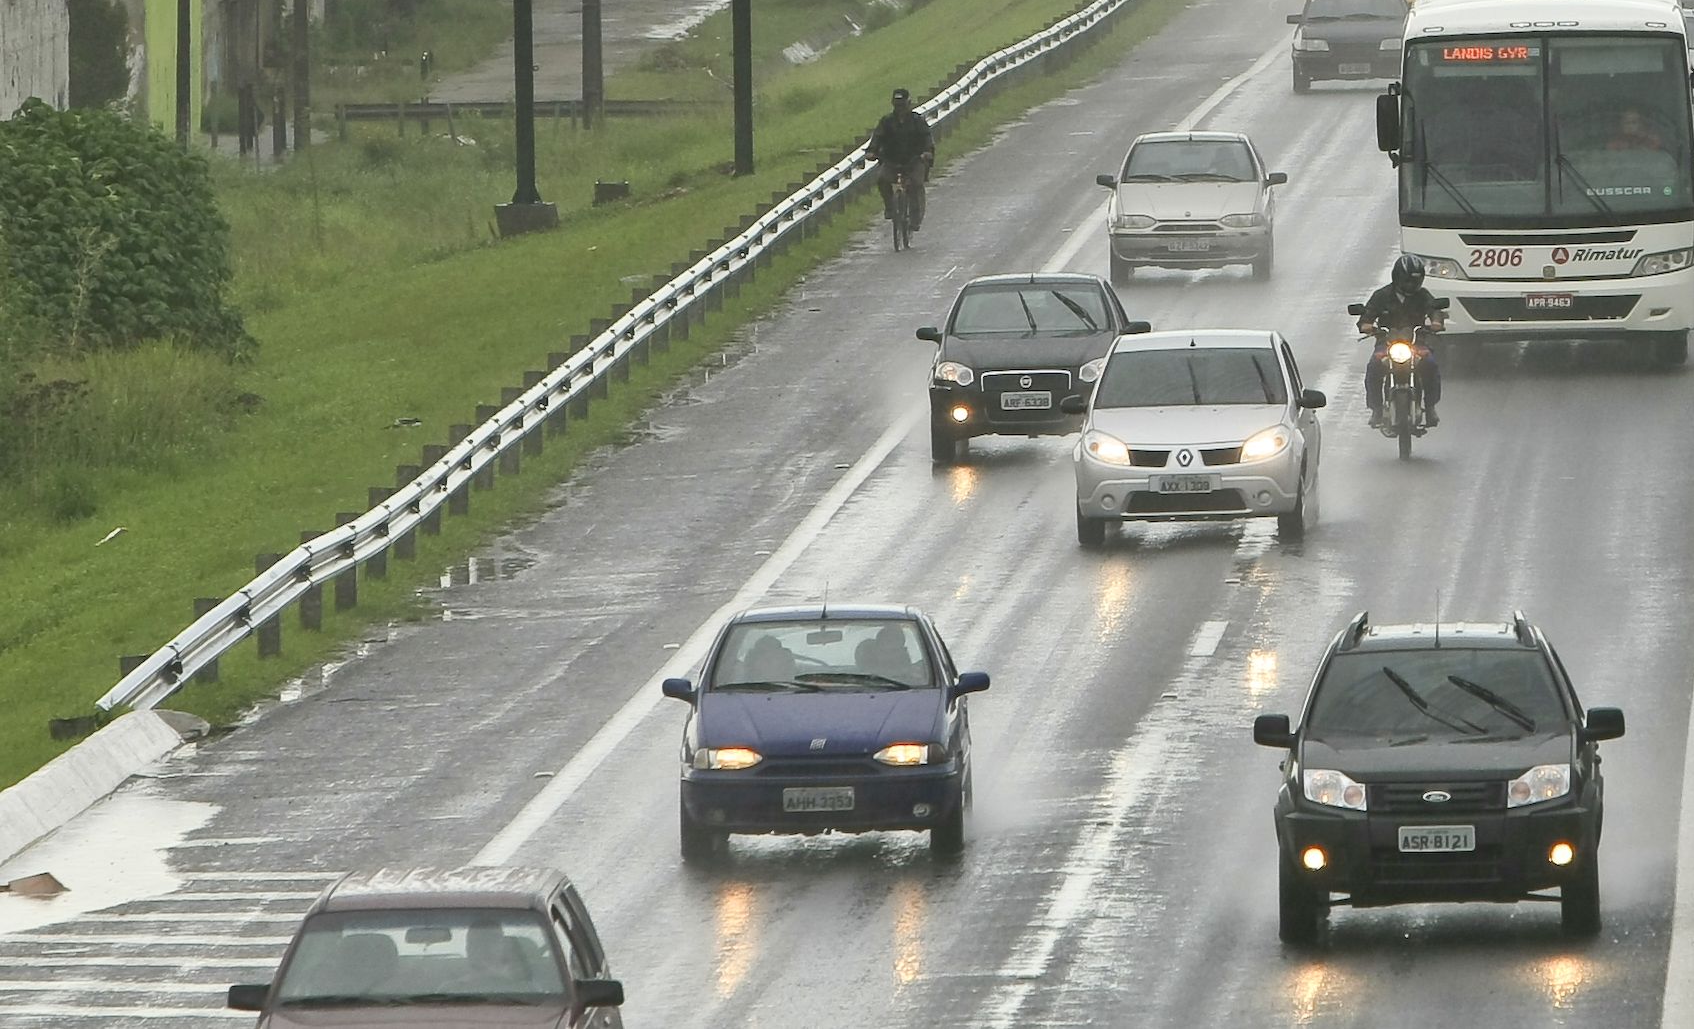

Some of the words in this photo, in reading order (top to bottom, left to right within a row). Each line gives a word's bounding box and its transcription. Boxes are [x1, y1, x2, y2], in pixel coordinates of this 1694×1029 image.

[1443, 47, 1493, 60] LANDIS
[1498, 46, 1528, 59] GYR
[1586, 186, 1652, 197] BUSSCAR
[1468, 248, 1524, 268] 2806
[1571, 246, 1644, 263] Rimatur
